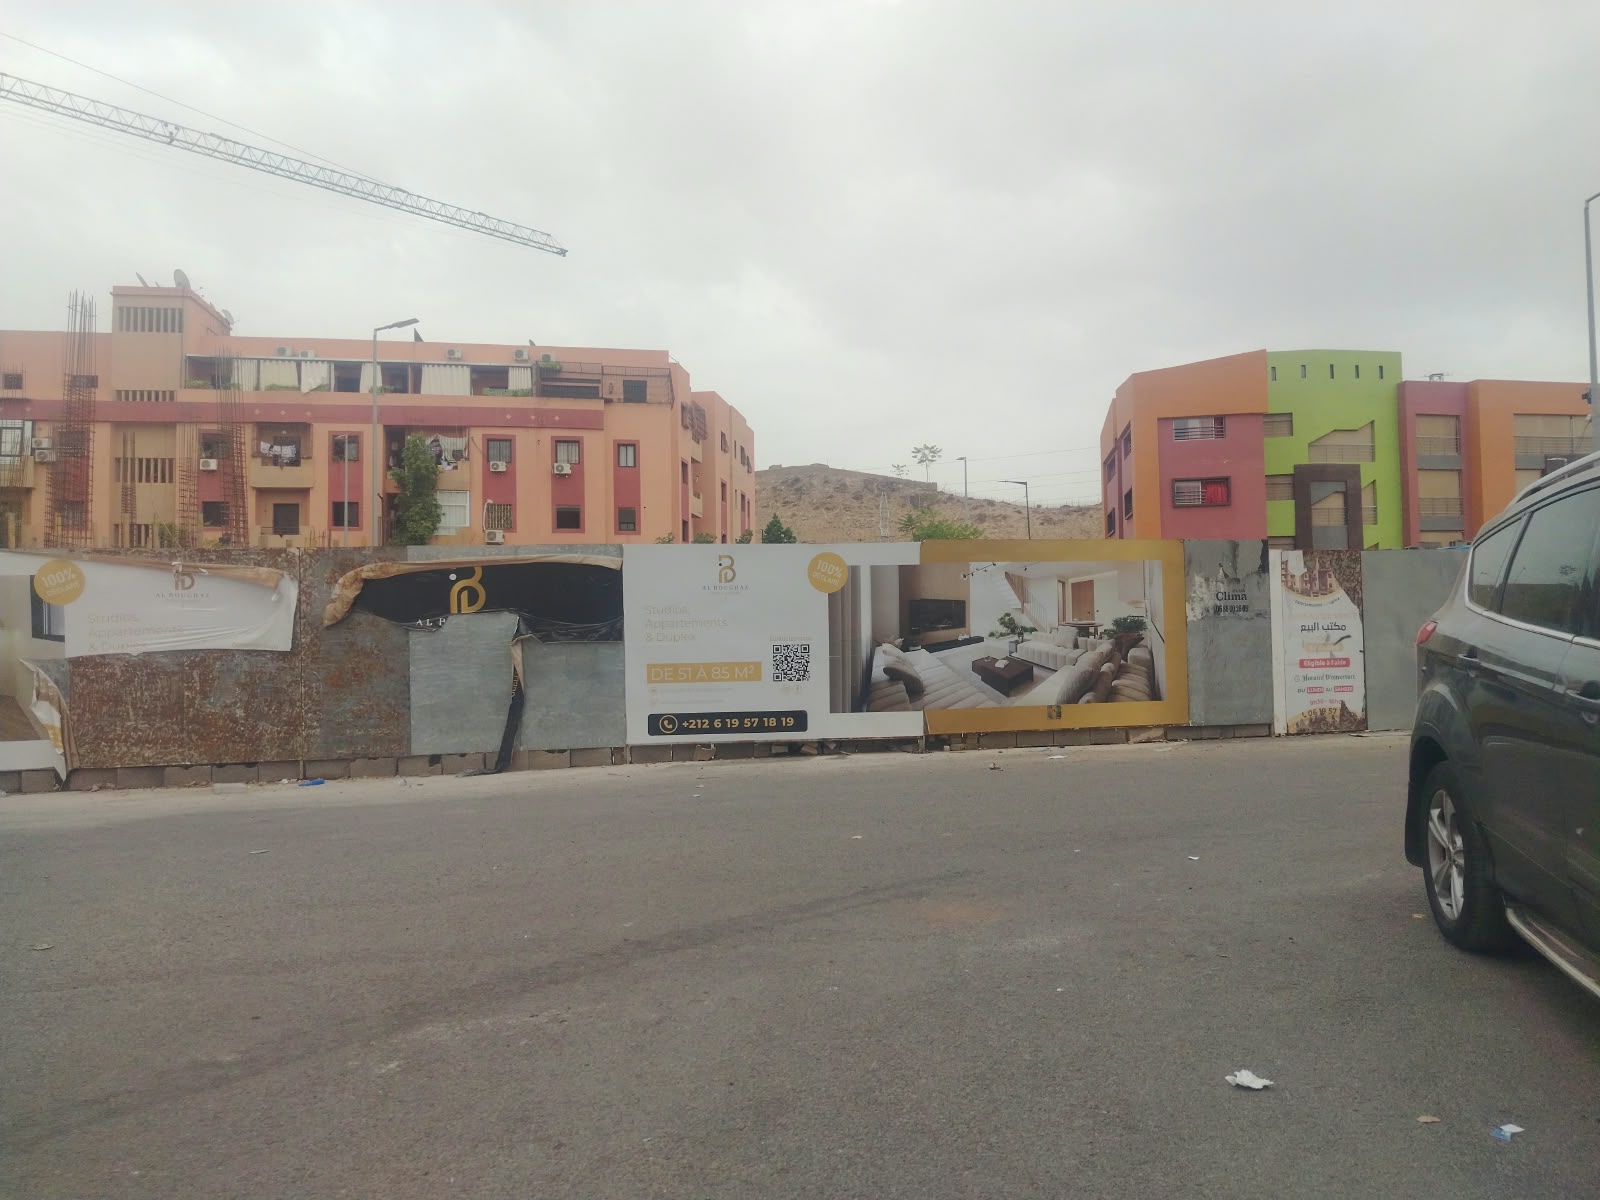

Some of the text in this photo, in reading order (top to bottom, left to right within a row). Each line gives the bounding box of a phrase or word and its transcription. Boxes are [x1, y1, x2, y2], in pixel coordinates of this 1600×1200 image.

[816, 559, 842, 578] 100%
[41, 568, 76, 588] 100%
[1216, 591, 1248, 601] Clima
[416, 618, 433, 626] AL
[1300, 622, 1347, 633] مكتب البيع
[651, 667, 674, 681] DE
[678, 667, 692, 681] 51
[711, 666, 730, 679] 85
[1308, 709, 1318, 717] 06
[1328, 707, 1338, 715] 57
[682, 717, 794, 729] +212 6 19 57 18 19
